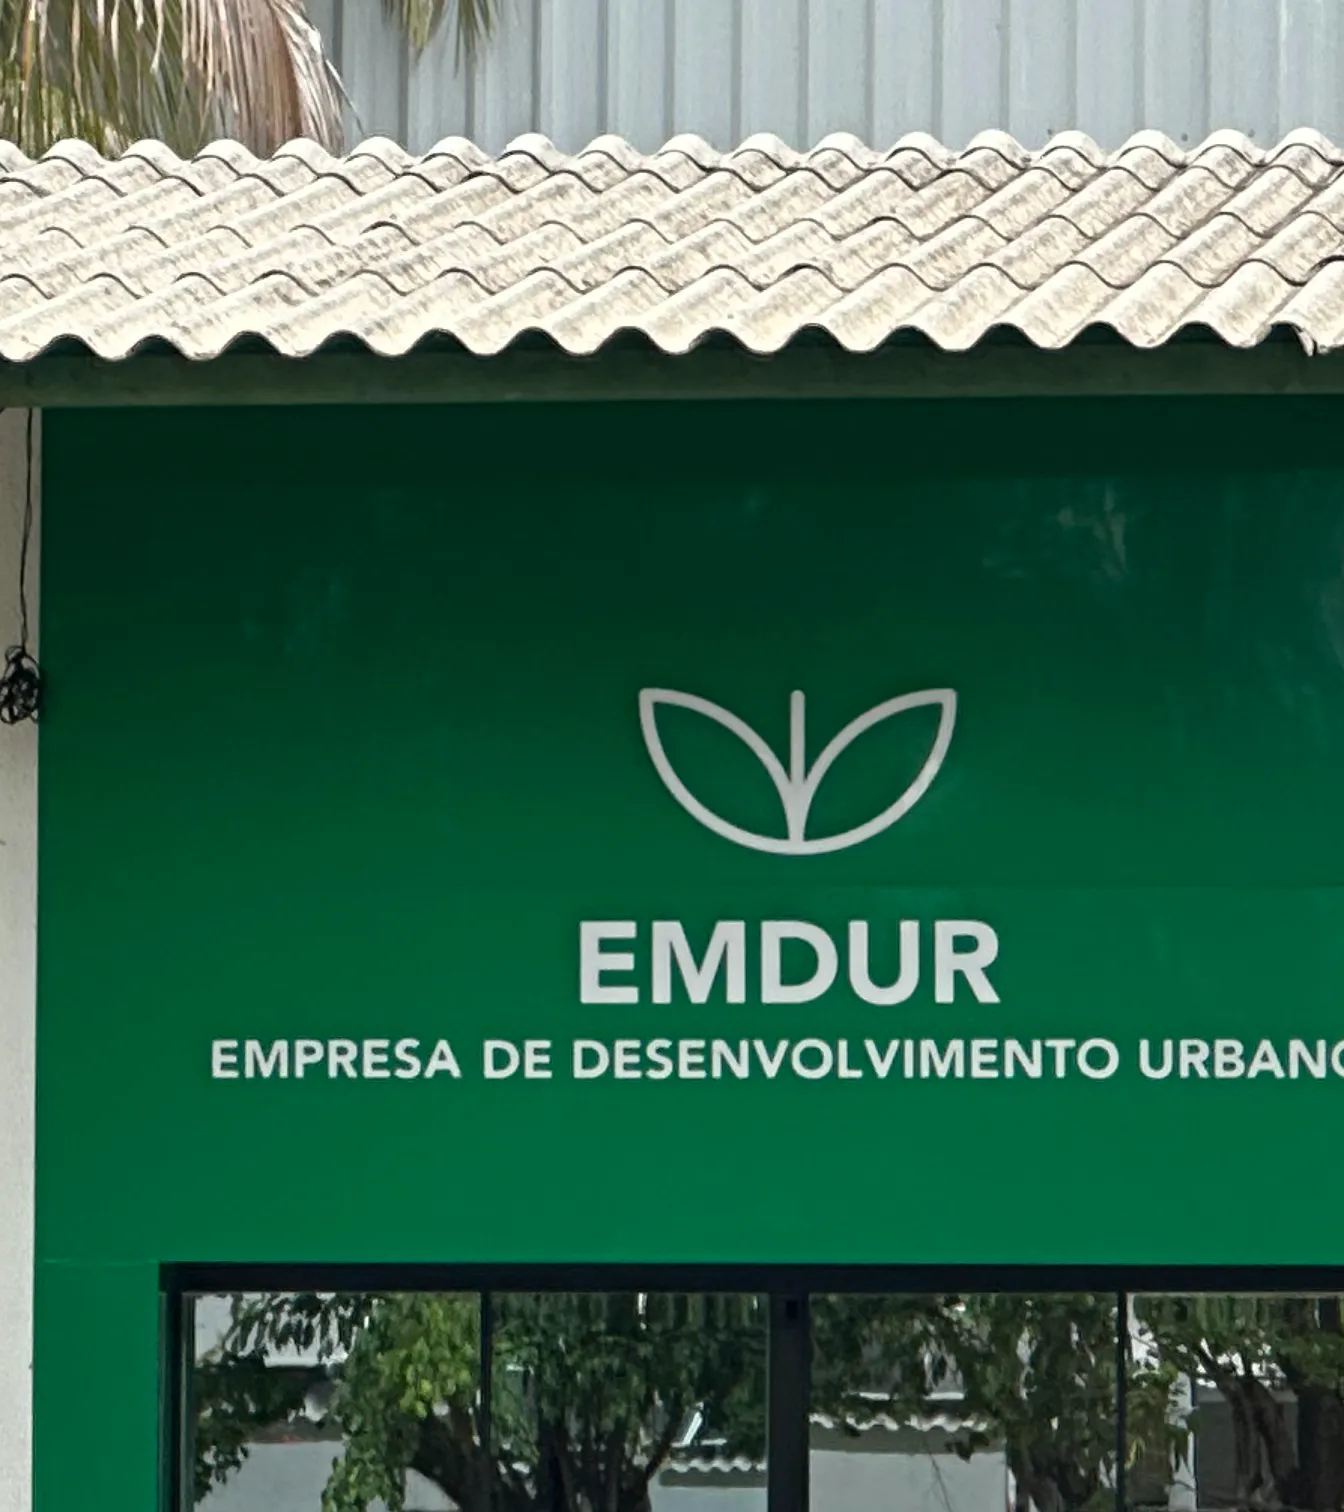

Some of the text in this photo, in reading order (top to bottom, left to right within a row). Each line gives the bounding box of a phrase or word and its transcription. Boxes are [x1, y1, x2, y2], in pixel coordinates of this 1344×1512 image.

[579, 919, 1001, 1006] EMDUR
[211, 1037, 462, 1079] EMPRESA
[483, 1038, 553, 1079] DE
[572, 1037, 1120, 1080] DESENVOLVIMENTO
